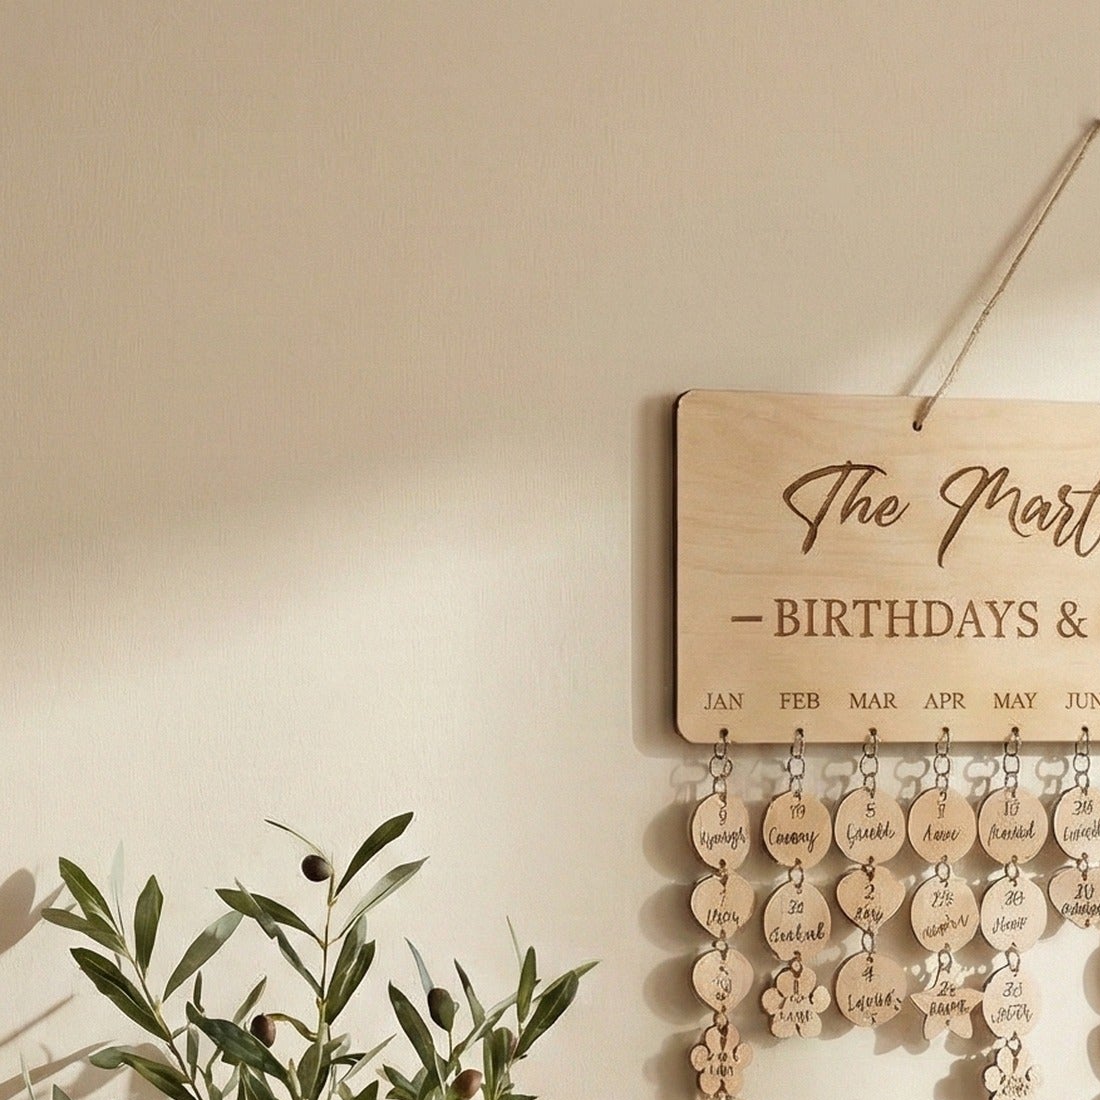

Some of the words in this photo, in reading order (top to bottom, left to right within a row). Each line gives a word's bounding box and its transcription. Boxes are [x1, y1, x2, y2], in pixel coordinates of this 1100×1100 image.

[781, 459, 911, 556] The
[773, 599, 1040, 640] BIRTHDAYS
[1055, 600, 1089, 639] &
[703, 692, 745, 710] JAN
[779, 692, 822, 710] FEB
[848, 692, 899, 710] MAR
[923, 692, 968, 710] APR
[992, 692, 1039, 710] MAY
